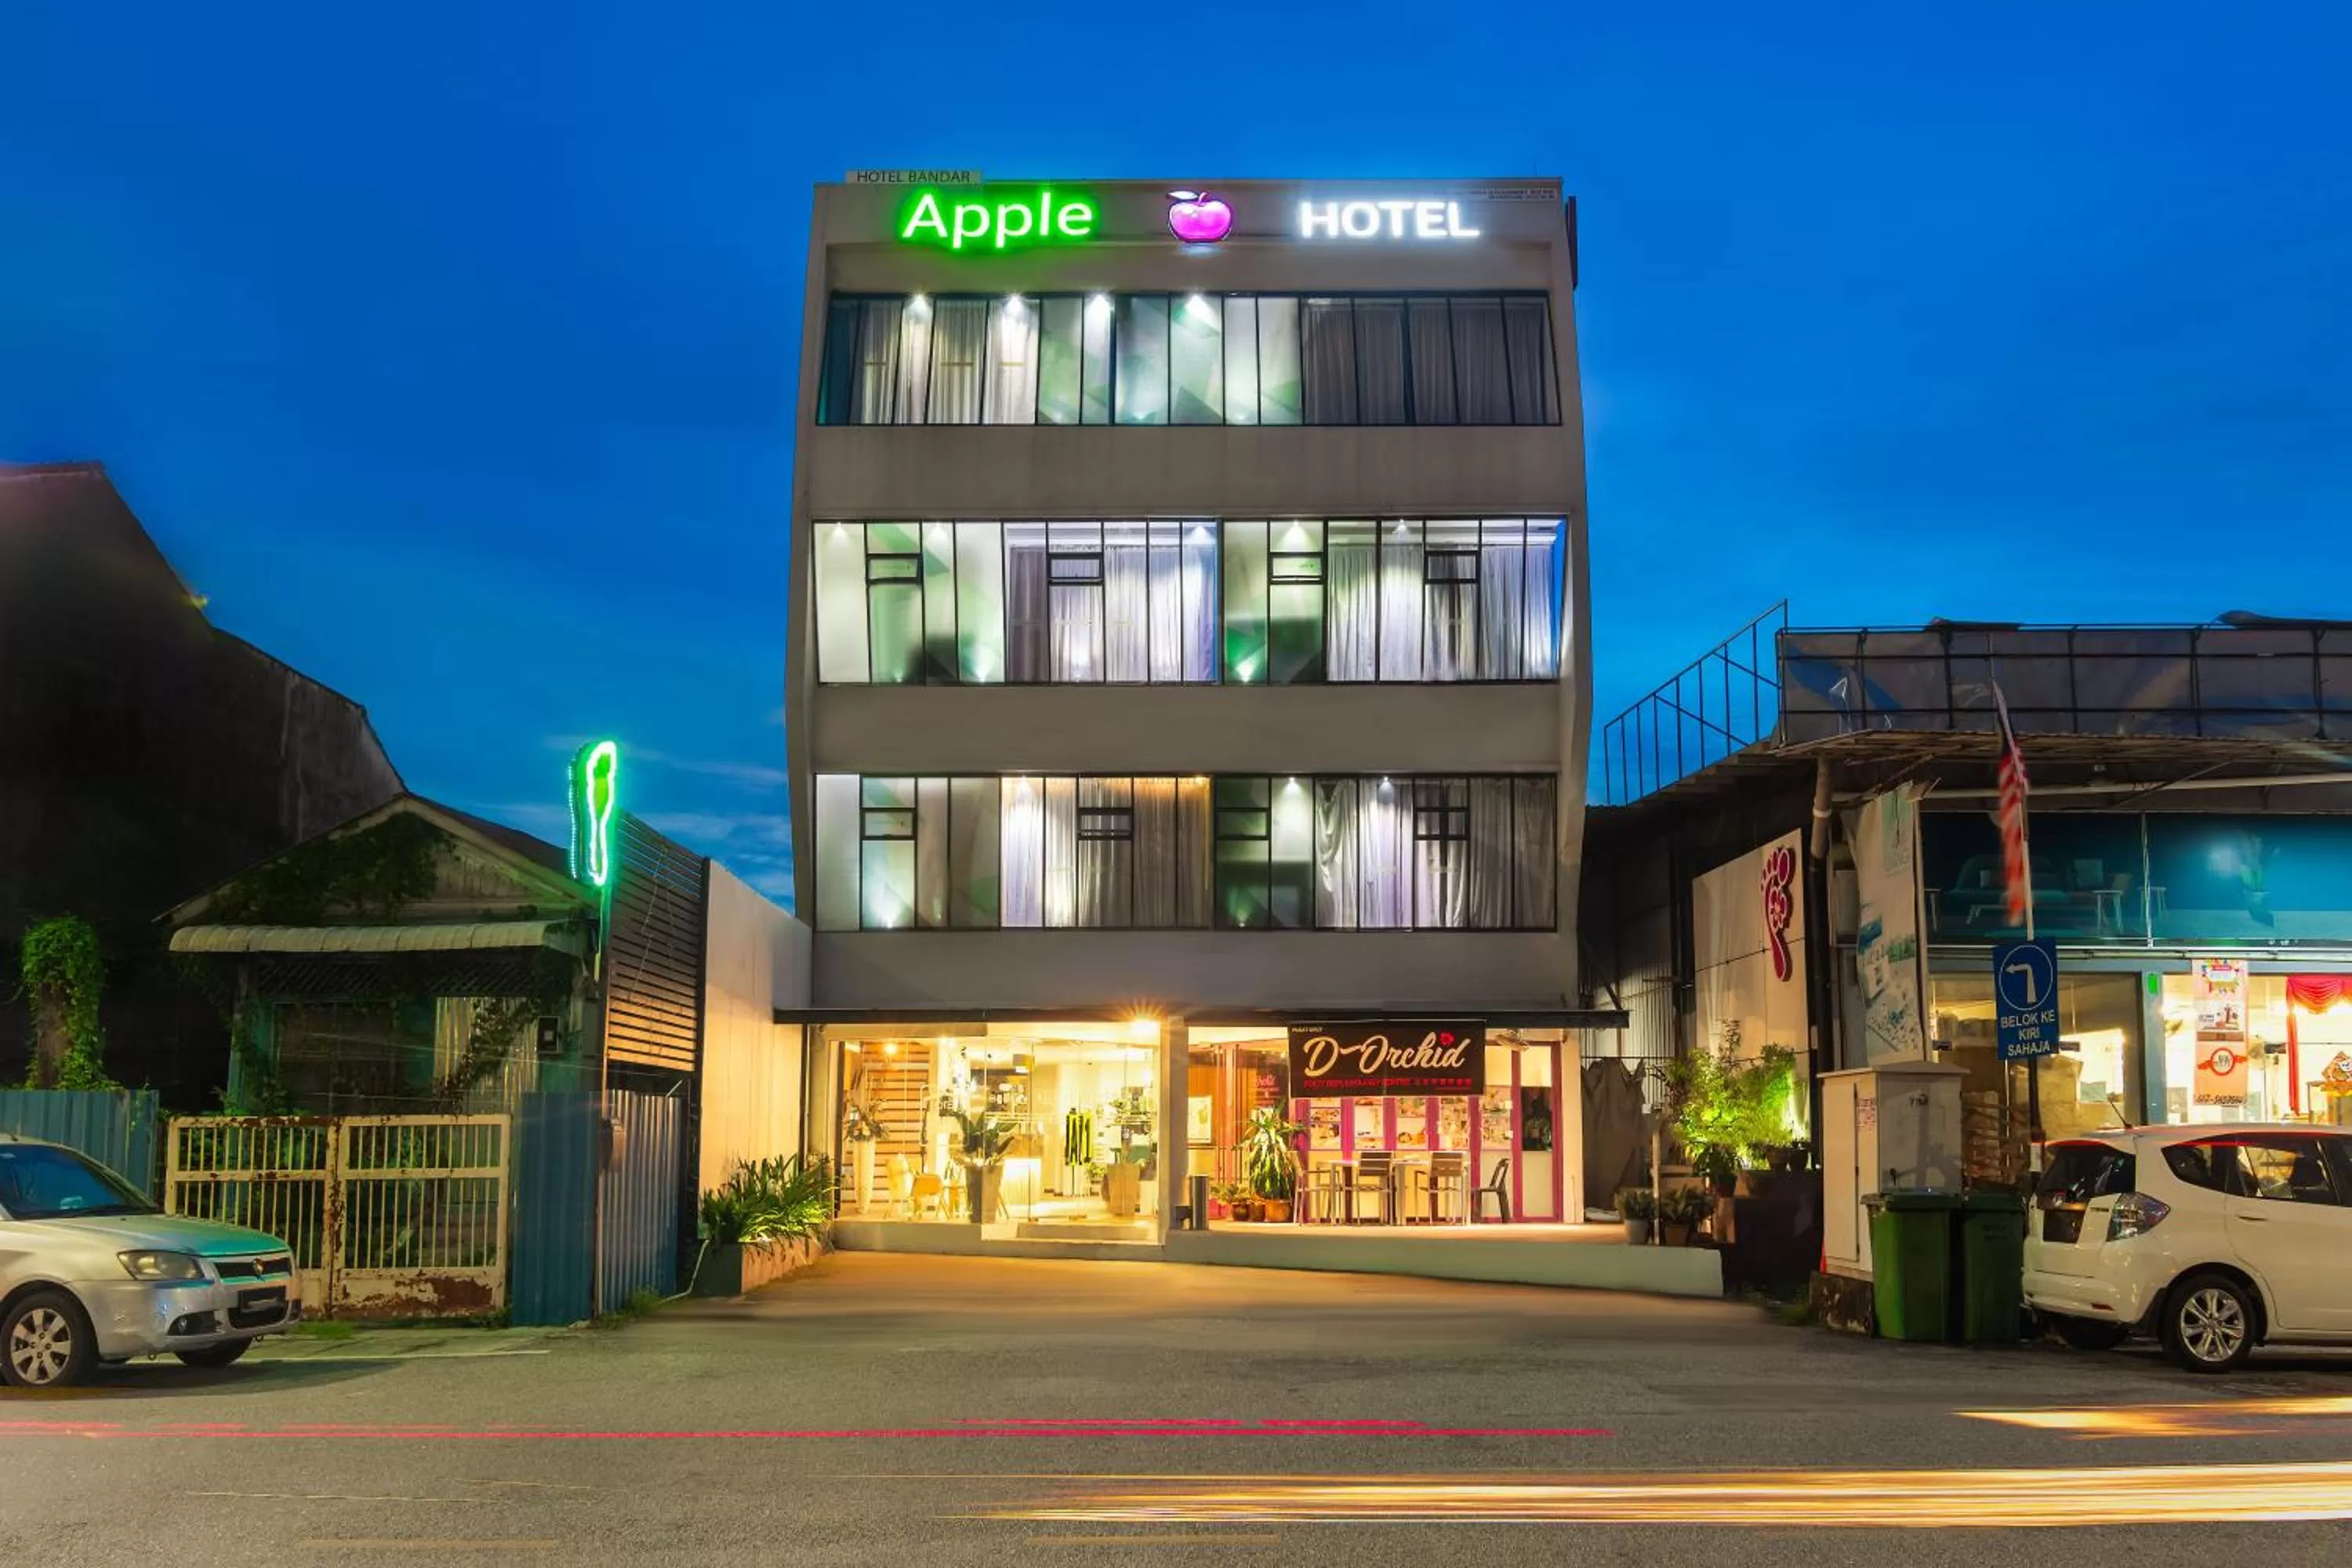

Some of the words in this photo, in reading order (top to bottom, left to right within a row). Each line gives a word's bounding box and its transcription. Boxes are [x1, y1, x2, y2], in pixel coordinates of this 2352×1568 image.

[856, 170, 904, 183] HOTEL
[909, 170, 971, 183] BANDAR
[902, 191, 1094, 249] Apple
[1300, 201, 1481, 239] HOTEL
[2000, 1013, 2039, 1029] BELOK
[2042, 1010, 2056, 1023] KE
[2018, 1028, 2041, 1041] KIRI
[2007, 1041, 2051, 1056] SAHAJA
